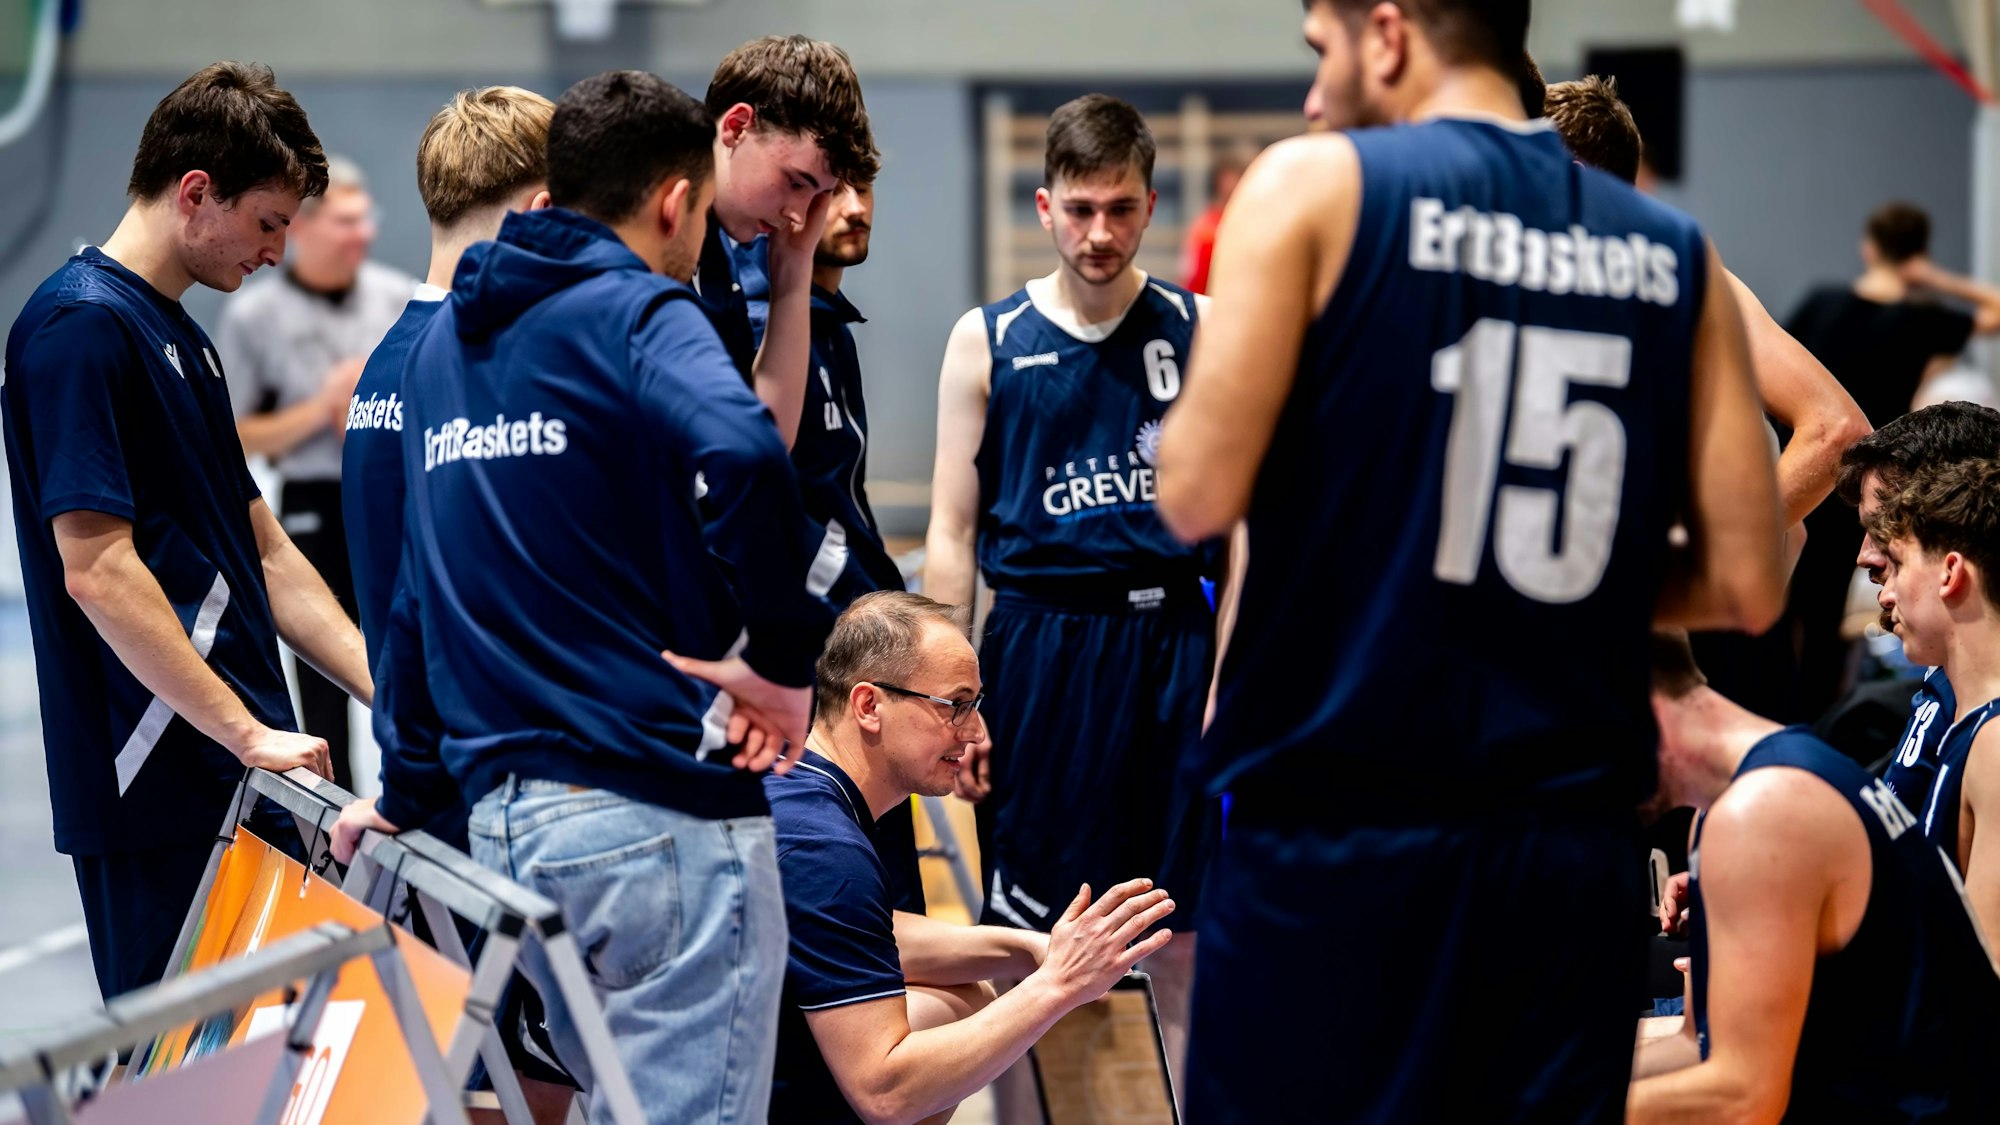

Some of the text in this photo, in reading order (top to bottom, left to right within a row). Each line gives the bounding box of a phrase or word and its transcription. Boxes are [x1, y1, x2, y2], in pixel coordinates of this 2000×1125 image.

[1143, 338, 1181, 402] 6
[1043, 469, 1162, 516] GREVE
[1045, 451, 1140, 482] PETER
[1430, 317, 1633, 604] 15
[1896, 700, 1940, 767] 13
